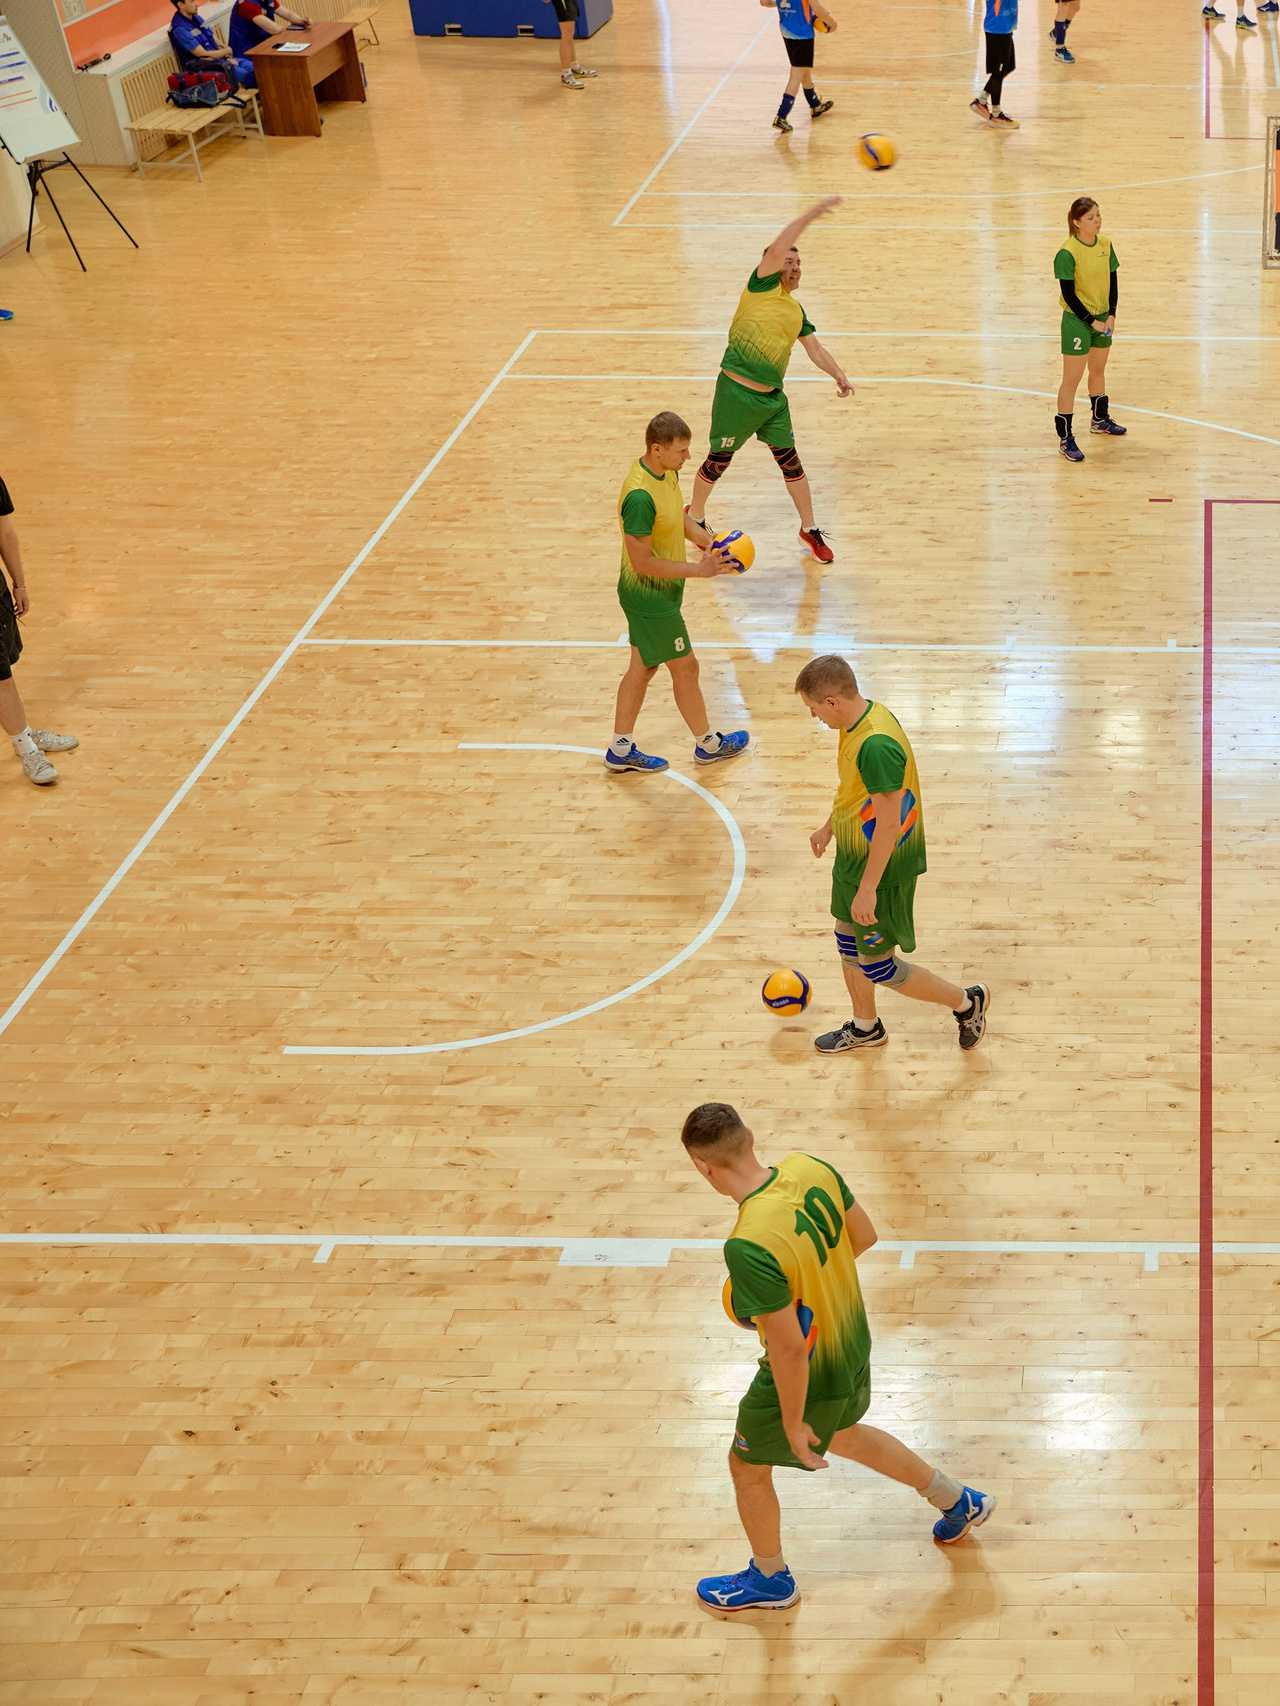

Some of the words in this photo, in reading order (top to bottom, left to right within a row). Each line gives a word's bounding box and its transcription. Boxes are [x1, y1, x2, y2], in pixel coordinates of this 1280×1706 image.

[1073, 337, 1082, 350] 2
[721, 436, 736, 448] 15
[674, 637, 686, 652] 8
[794, 1186, 843, 1268] 10
